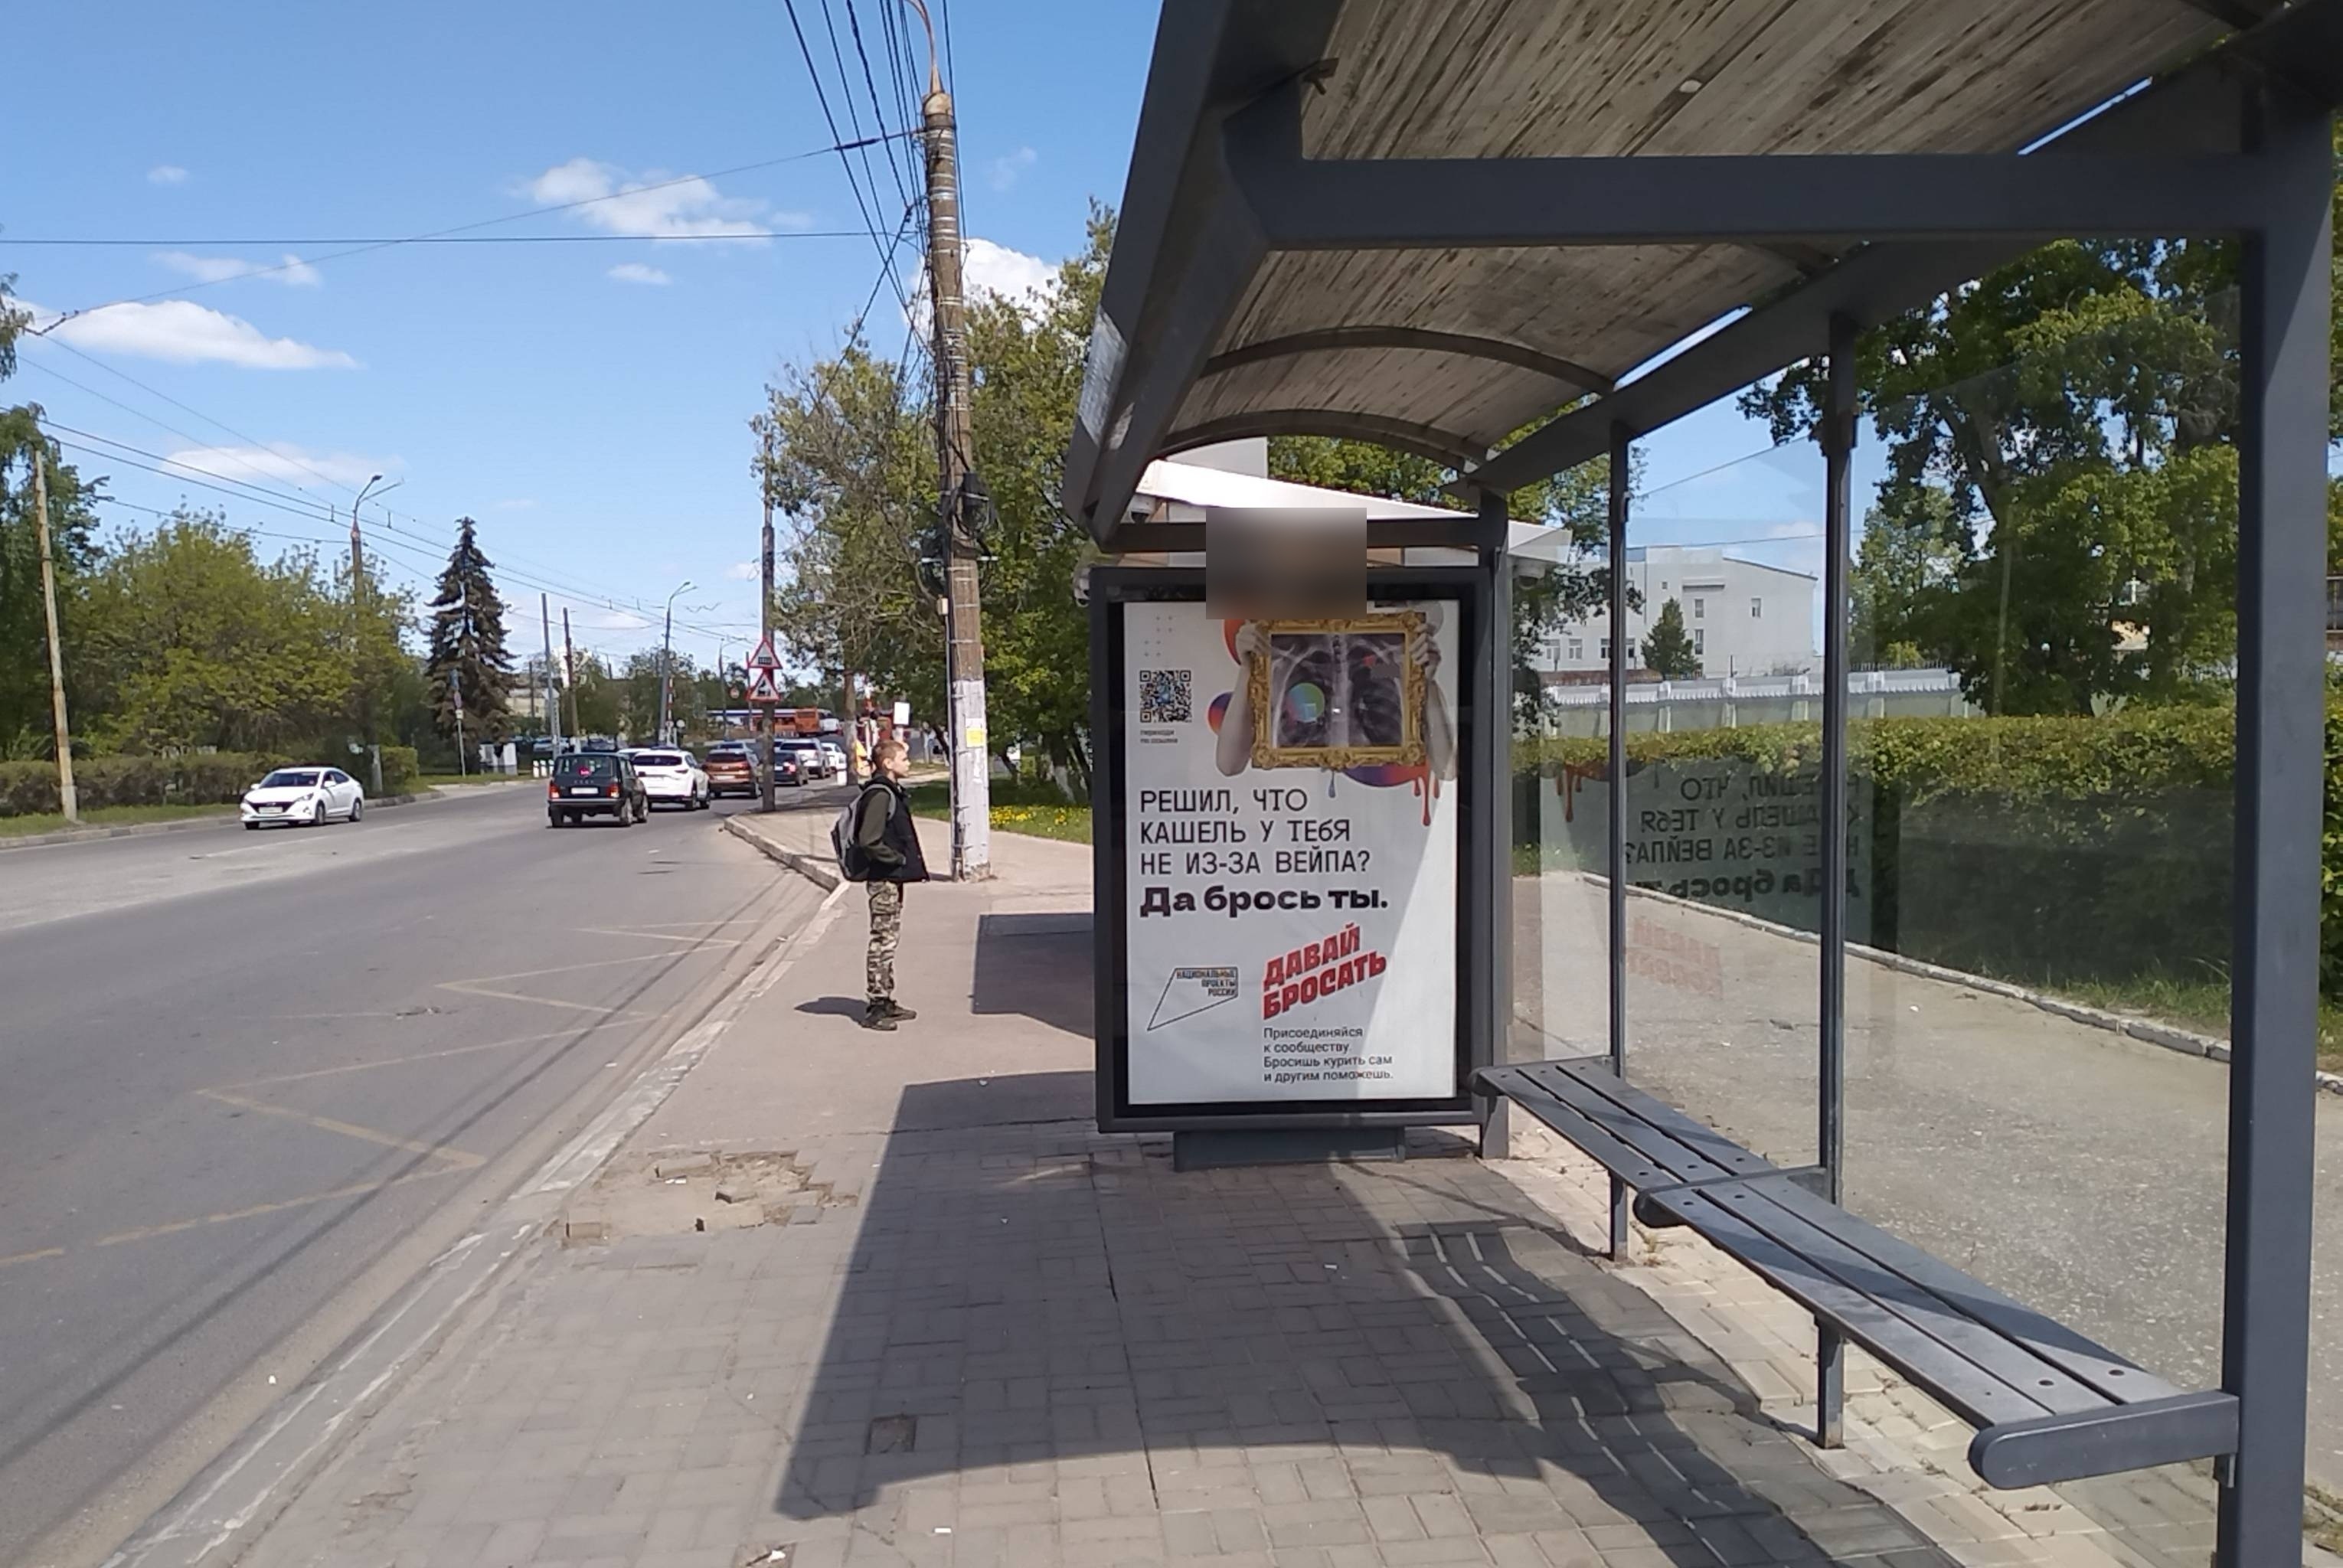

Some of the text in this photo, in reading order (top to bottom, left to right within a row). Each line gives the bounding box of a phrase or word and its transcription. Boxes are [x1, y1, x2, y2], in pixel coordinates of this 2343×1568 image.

[1140, 789, 1308, 814] РЕШИЛ, ЧТО
[1140, 821, 1246, 844] КАШЕЛЬ
[1260, 821, 1274, 841] У
[1140, 845, 1371, 874] НЕ ИЗ-ЗА ВЕЙПА?
[1140, 885, 1388, 918] Да брось ты.
[1263, 922, 1361, 991] ДАВАЙ
[1263, 951, 1387, 1021] БРОСАТЬ
[1263, 1027, 1364, 1040] Присоединяйся
[1263, 1044, 1271, 1053] к
[1263, 1056, 1393, 1070] Бросишь курить сам
[1263, 1070, 1394, 1084] и другим поможешь.
